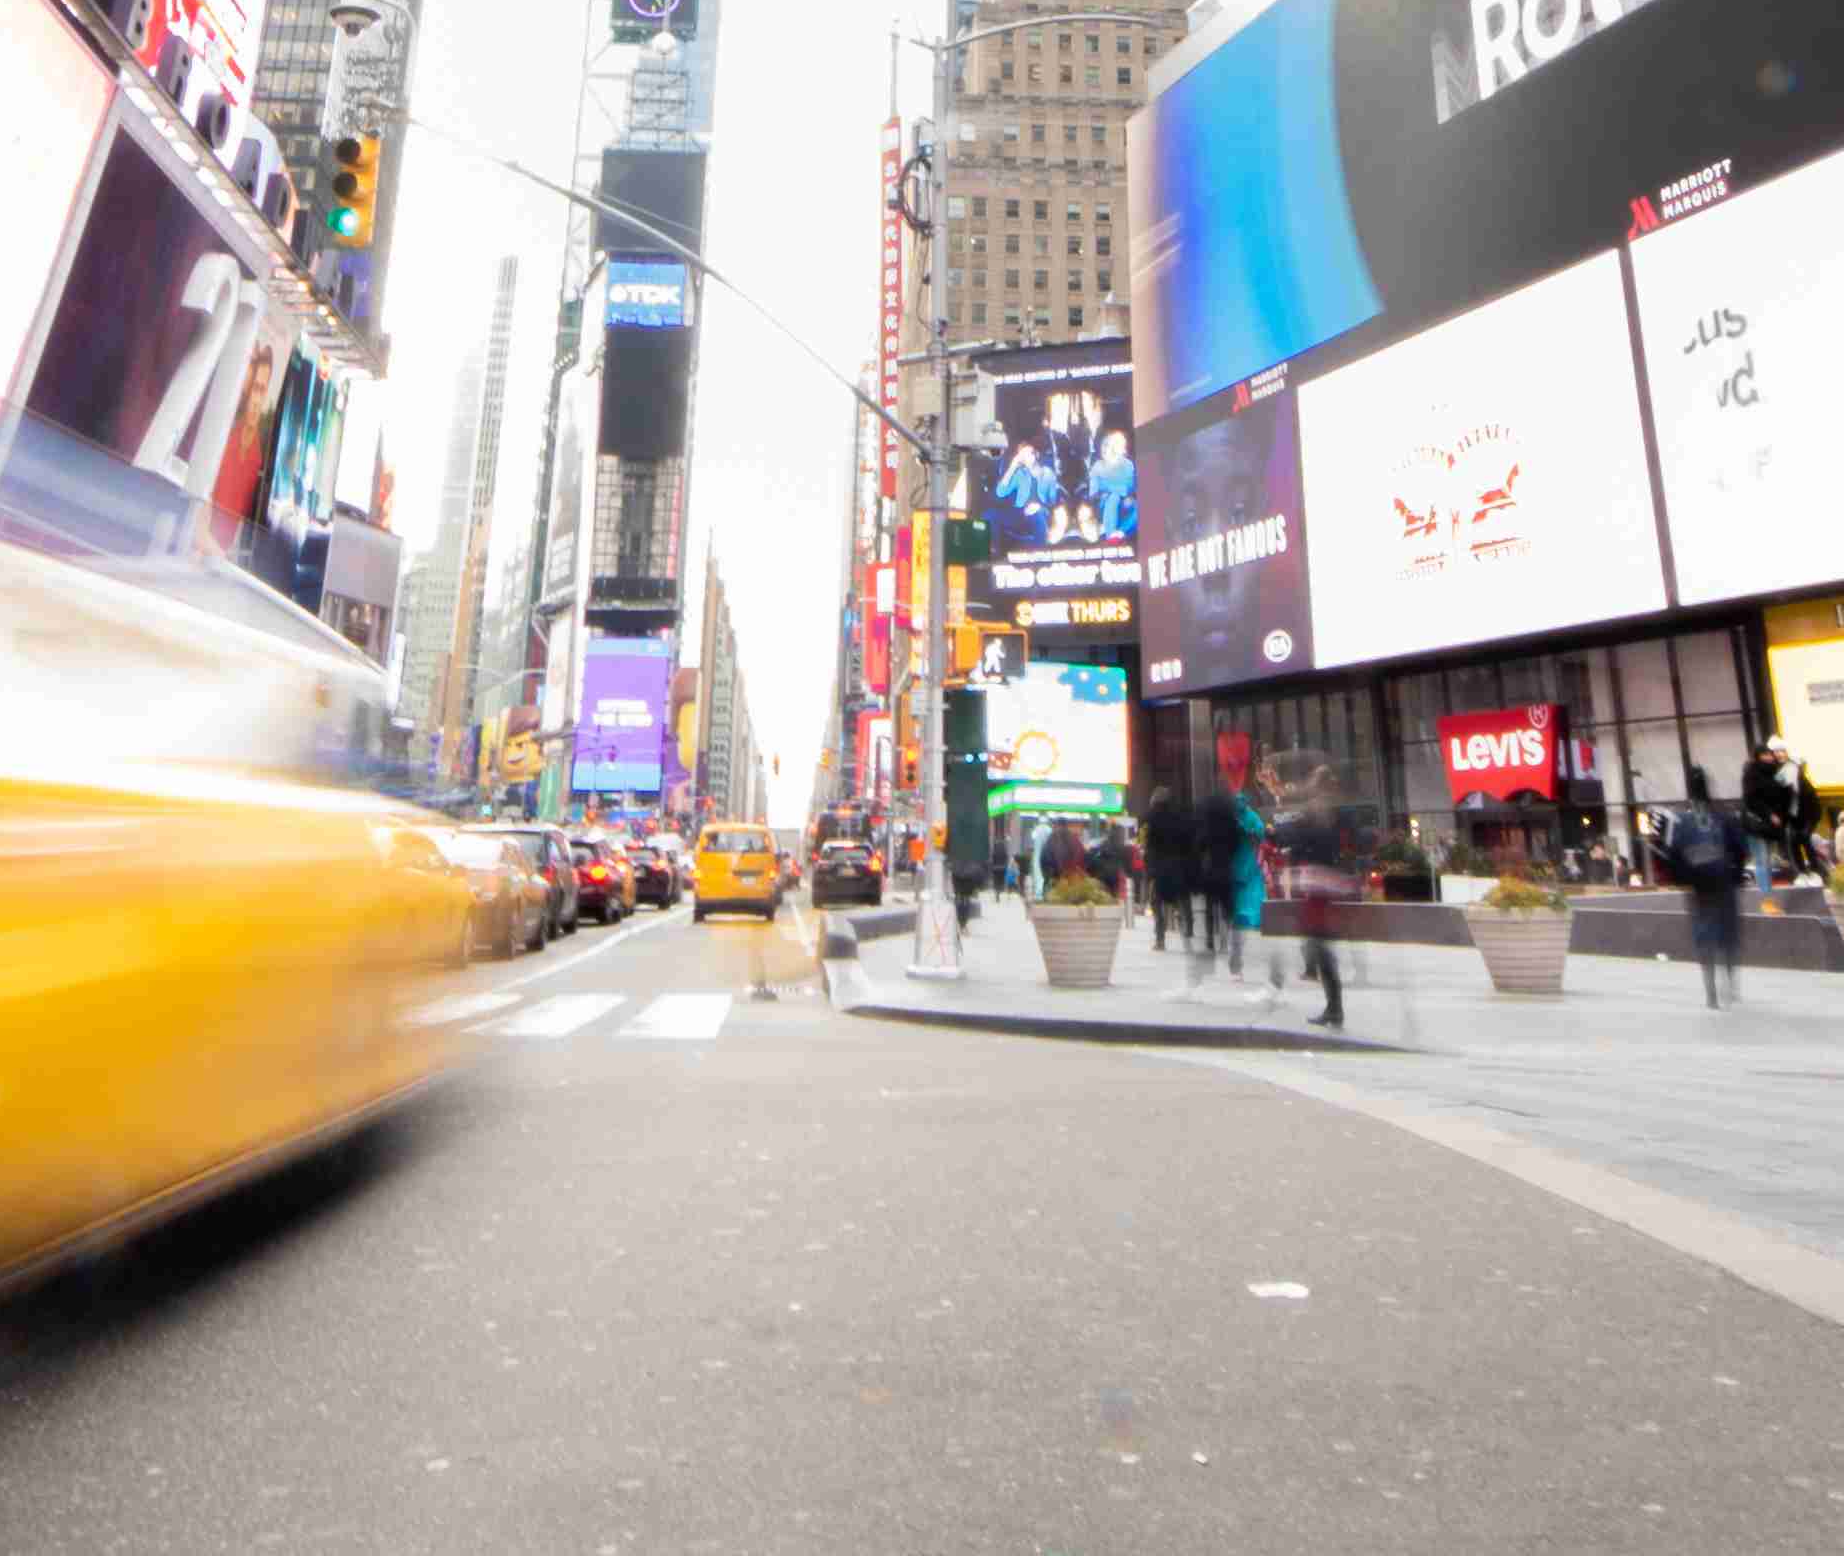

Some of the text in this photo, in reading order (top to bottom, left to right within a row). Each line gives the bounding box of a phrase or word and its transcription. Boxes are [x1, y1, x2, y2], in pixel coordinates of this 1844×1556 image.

[1660, 157, 1732, 202] MARRIOTT
[1663, 180, 1727, 220] MARQUIS
[1147, 512, 1288, 589] WE ARE NOT FAMOUS
